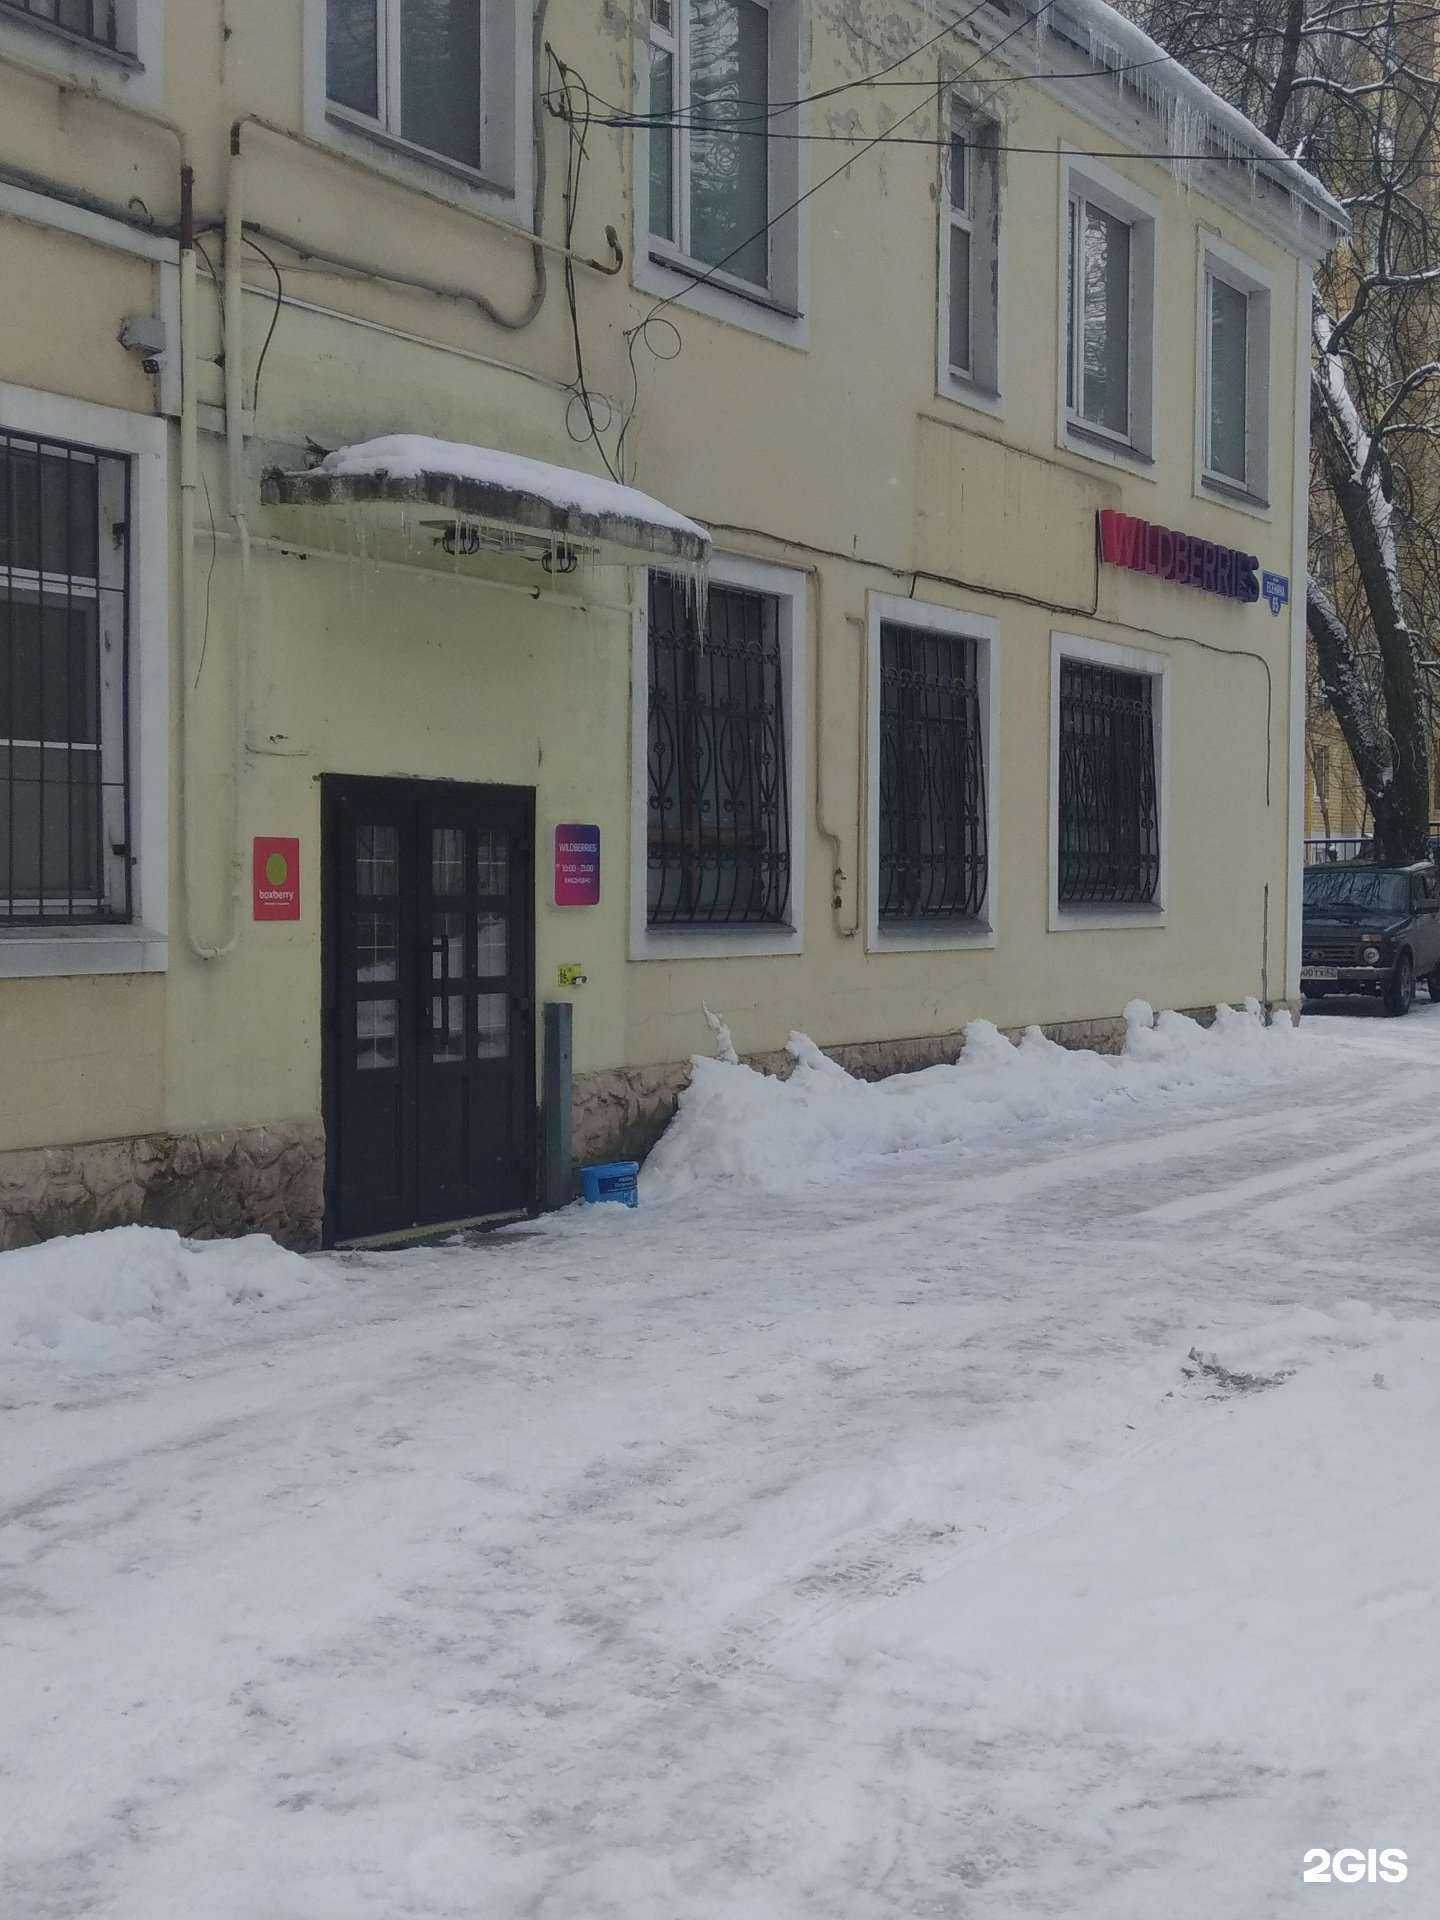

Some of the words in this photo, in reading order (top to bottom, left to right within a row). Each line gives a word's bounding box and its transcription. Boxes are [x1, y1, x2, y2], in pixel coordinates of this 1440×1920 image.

[1101, 509, 1260, 602] WILDBERRIES
[559, 842, 597, 852] WILDBERRIES
[259, 889, 294, 901] boxberry
